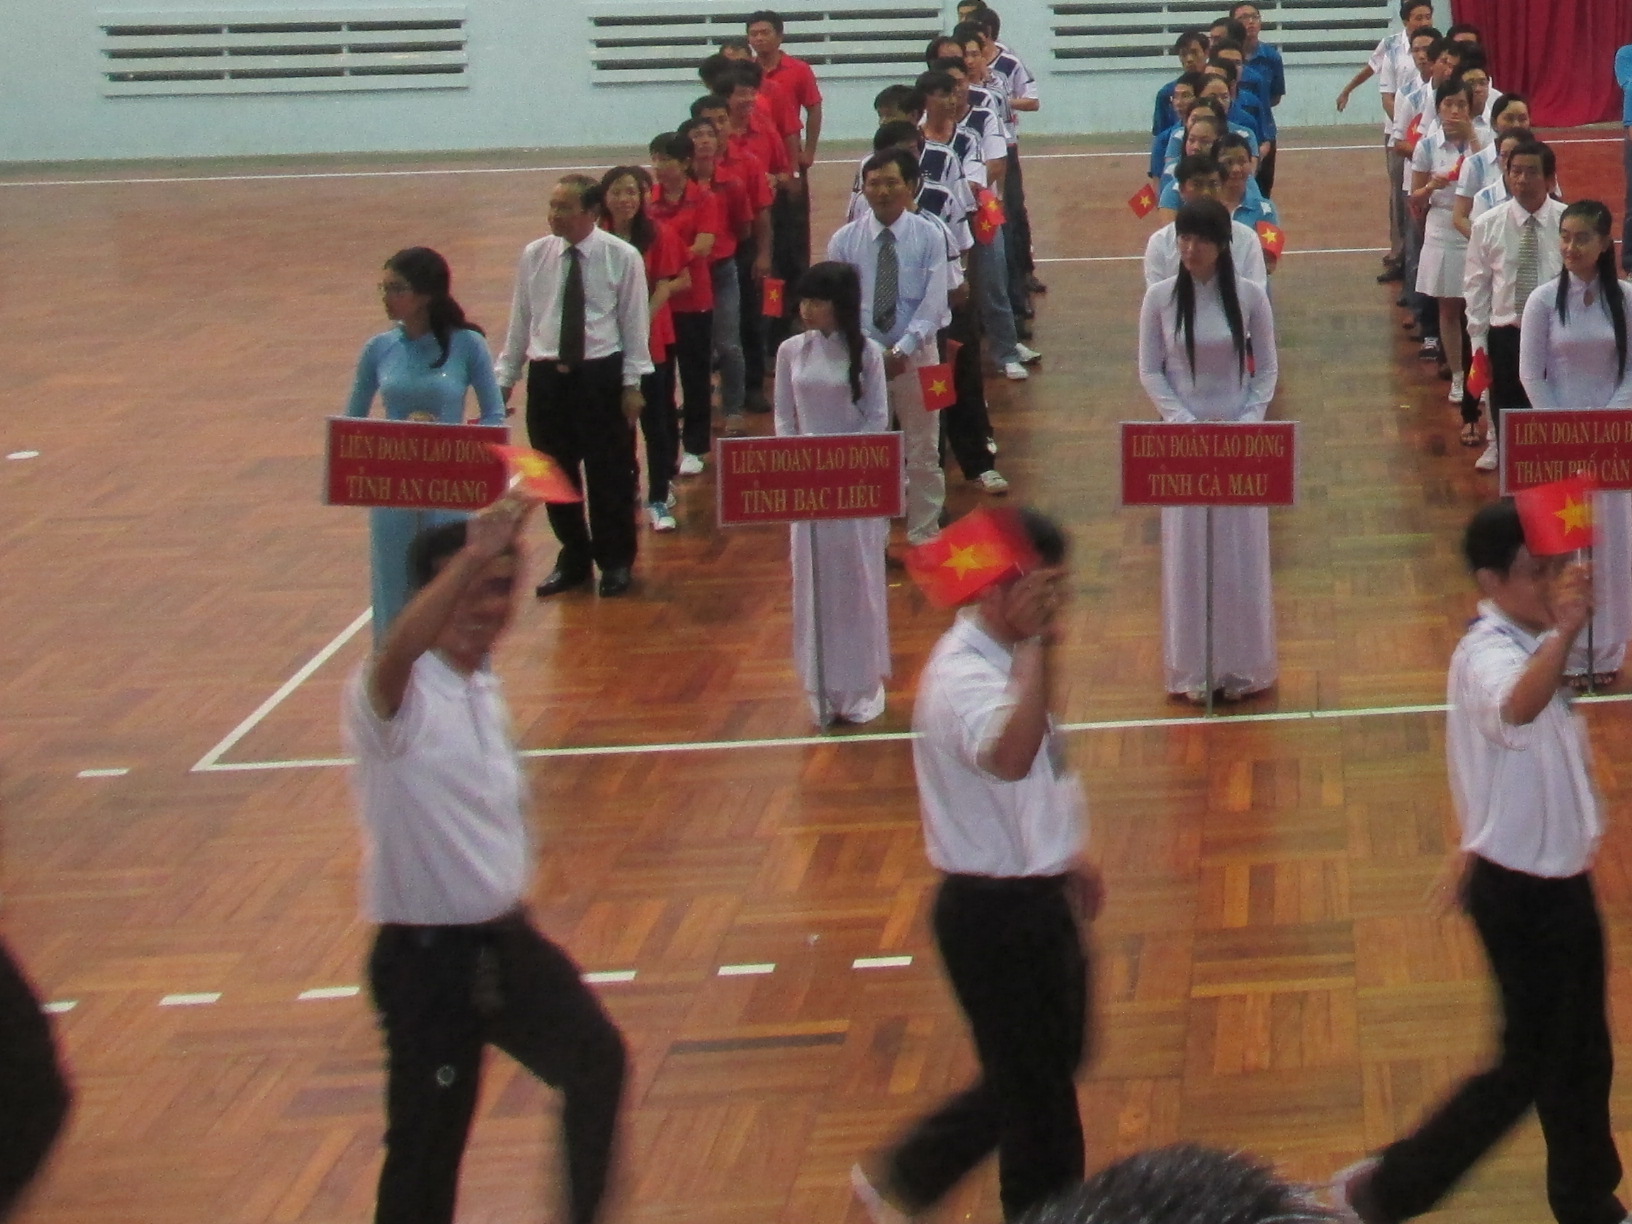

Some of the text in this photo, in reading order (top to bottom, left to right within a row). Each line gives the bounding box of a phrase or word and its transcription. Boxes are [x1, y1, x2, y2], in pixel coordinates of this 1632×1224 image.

[1515, 417, 1548, 445] LIÊN
[1594, 421, 1620, 443] LAO
[423, 439, 451, 462] LAO
[1213, 435, 1239, 457] LAO
[817, 448, 844, 470] LAO
[398, 479, 423, 501] AN
[428, 479, 487, 503] GIANG
[1227, 474, 1268, 496] MAU
